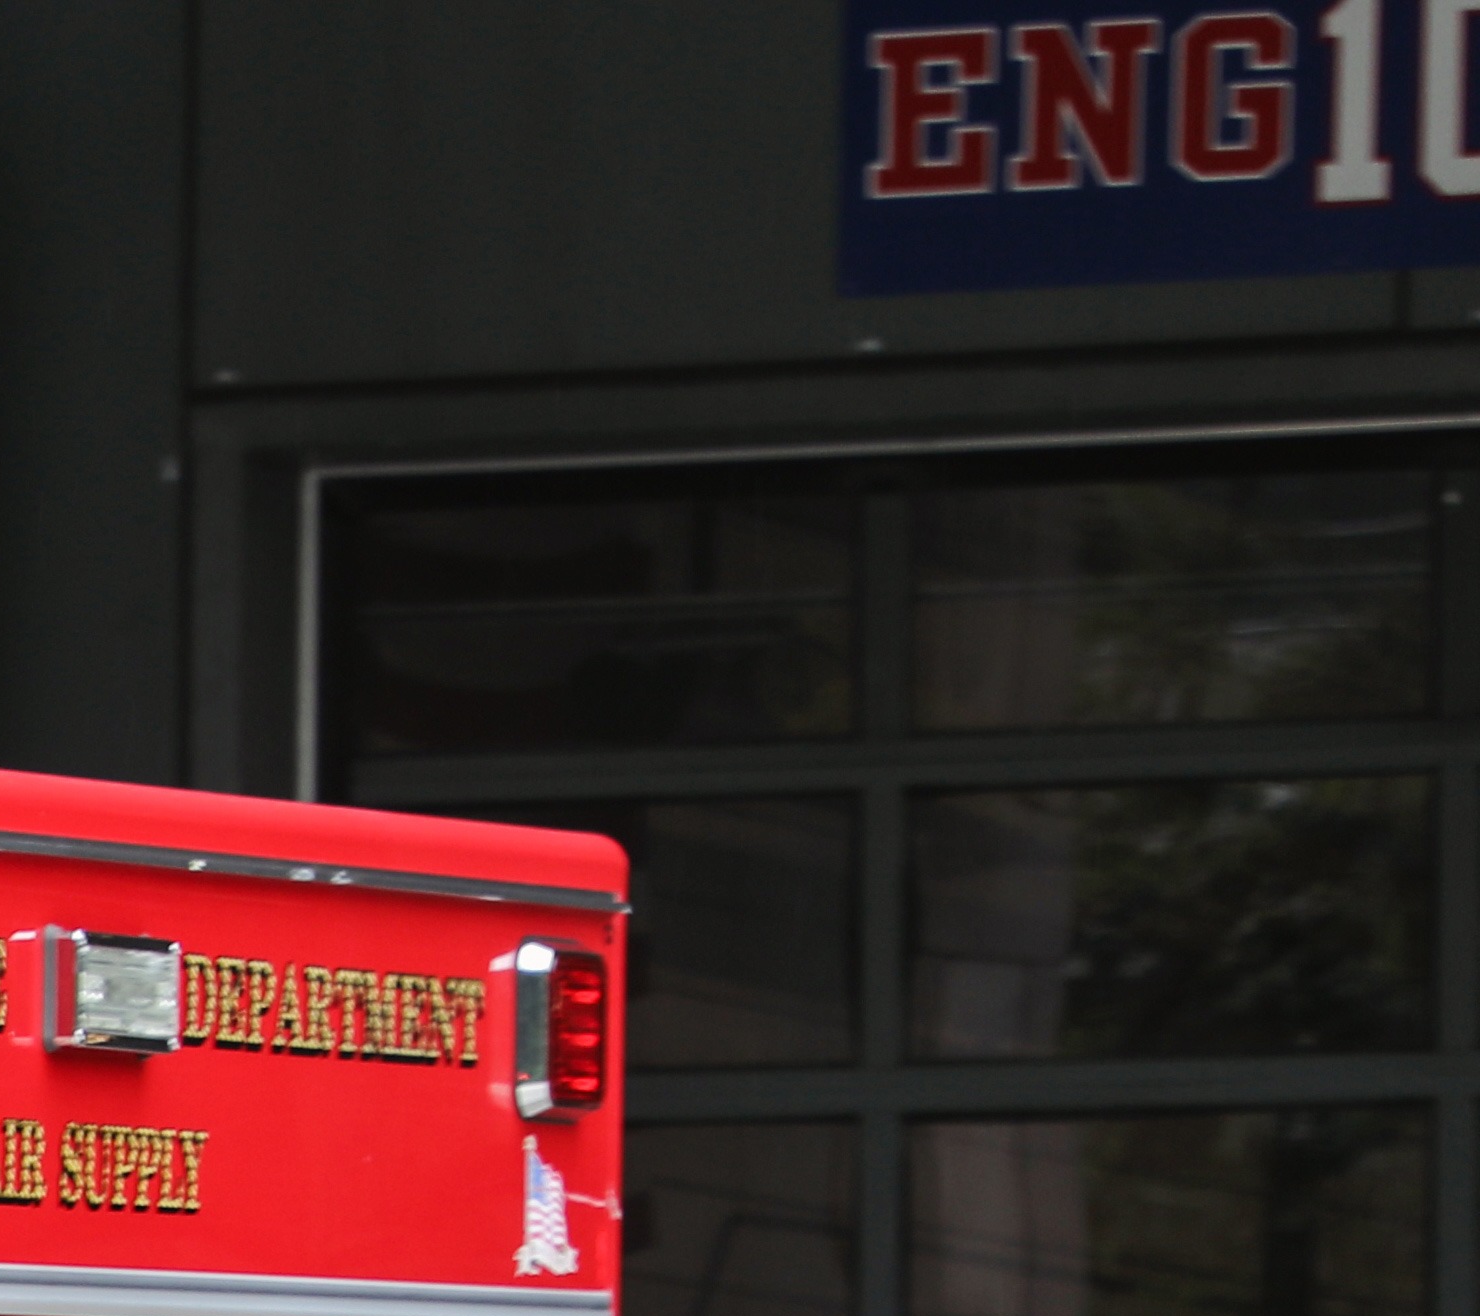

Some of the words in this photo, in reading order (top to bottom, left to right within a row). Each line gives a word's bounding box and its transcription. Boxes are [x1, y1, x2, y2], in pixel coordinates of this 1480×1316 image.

[864, 11, 1299, 199] ENG
[182, 953, 485, 1067] DEPARTMENT
[60, 1122, 209, 1214] SUPPLY
